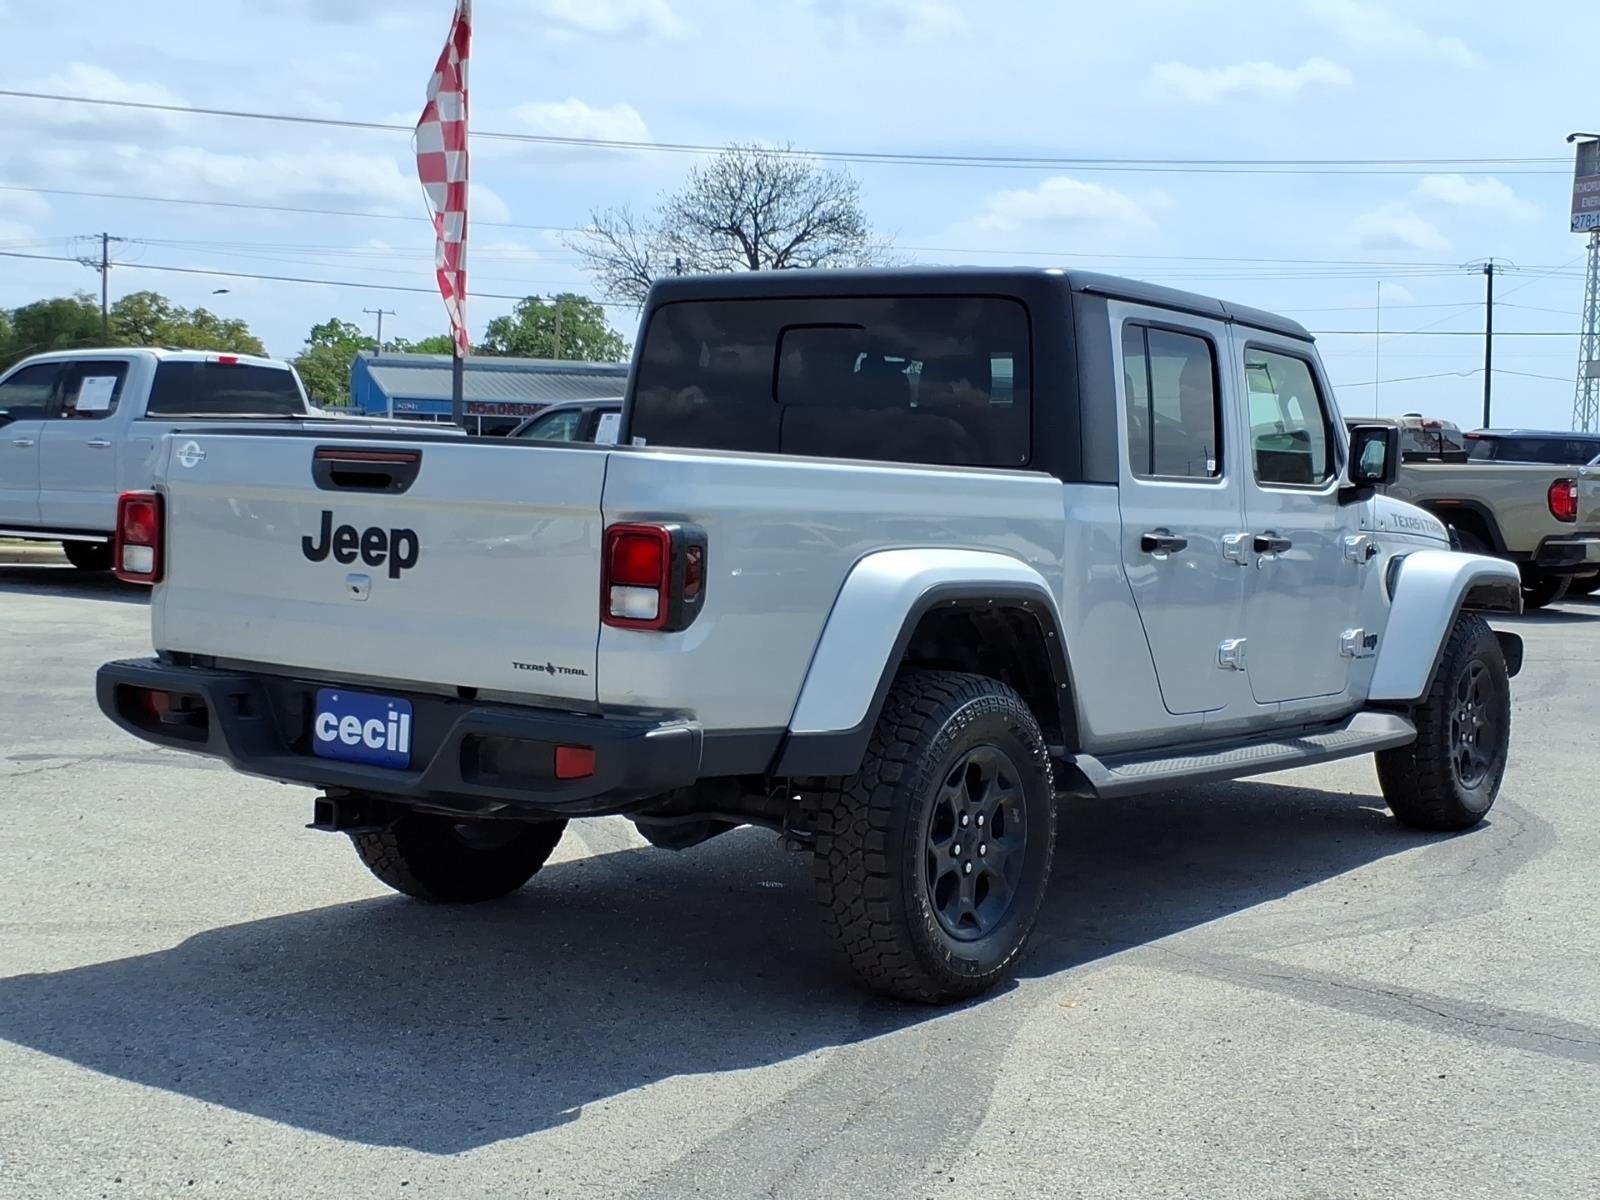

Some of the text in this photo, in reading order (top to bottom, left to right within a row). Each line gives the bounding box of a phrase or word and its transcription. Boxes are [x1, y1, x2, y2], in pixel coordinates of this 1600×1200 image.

[302, 510, 419, 580] Jeep
[512, 662, 589, 677] TEXAS TRAIL
[315, 711, 410, 753] cecil
